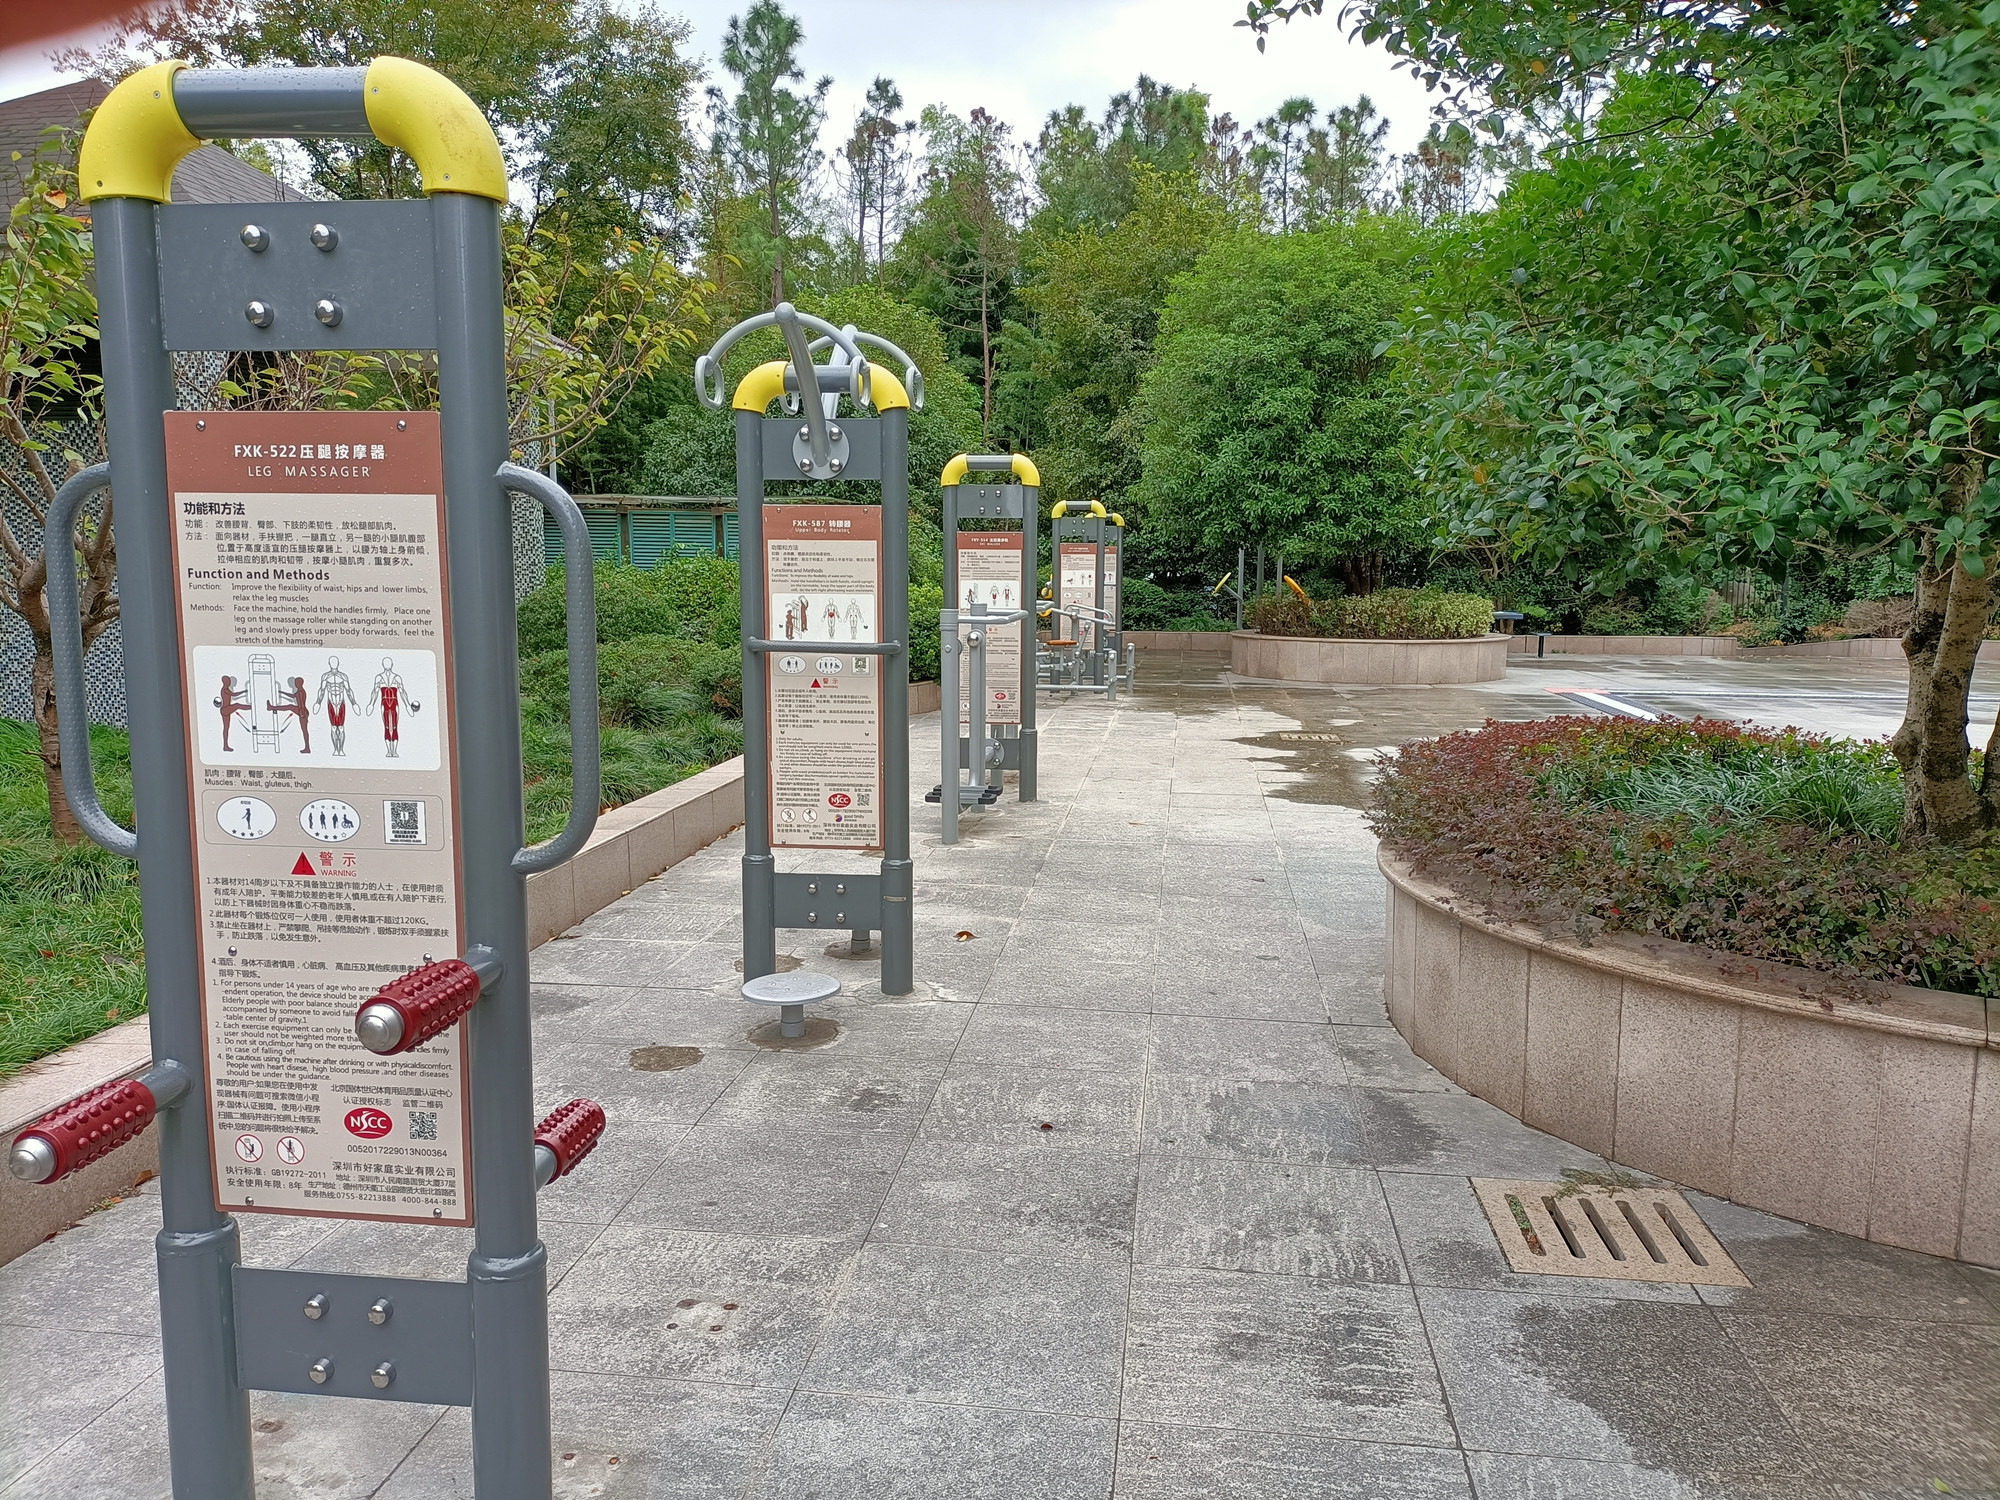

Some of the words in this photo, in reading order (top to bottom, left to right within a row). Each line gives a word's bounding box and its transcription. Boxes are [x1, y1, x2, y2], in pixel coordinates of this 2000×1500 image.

[233, 444, 385, 460] FXK-522压腿按摩器
[248, 465, 271, 476] LEG
[285, 465, 370, 477] MASSAGER
[183, 501, 245, 515] 功能和方法
[187, 567, 242, 579] Function
[245, 568, 269, 579] and
[272, 568, 329, 580] Methods
[231, 582, 262, 592] Improve
[278, 583, 312, 593] flexibility
[346, 584, 362, 594] hips
[232, 593, 250, 601] relax
[265, 594, 277, 603] leg
[279, 594, 309, 602] muscles
[333, 605, 363, 613] handles
[393, 606, 414, 614] Place
[233, 614, 245, 624] leg
[272, 617, 305, 625] massage
[327, 616, 348, 624] while
[349, 616, 388, 626] stangding
[401, 617, 432, 625] another
[234, 625, 246, 634] leg
[265, 626, 289, 635] slowly
[339, 627, 360, 637] body
[404, 628, 419, 636] feel
[421, 628, 434, 636] the
[234, 636, 260, 644] stretch
[261, 636, 270, 644] of
[271, 636, 284, 644] the
[240, 779, 262, 787] Waist,
[264, 780, 292, 789] gluteus,
[831, 795, 848, 804] NSCC
[319, 851, 356, 867] 警示
[320, 869, 356, 877] WARNING
[241, 1022, 269, 1030] exercise
[270, 1022, 309, 1033] equipment
[325, 1026, 341, 1034] only
[235, 1053, 261, 1061] cautious
[262, 1054, 281, 1064] using
[281, 1055, 292, 1063] the
[293, 1056, 321, 1064] machine
[338, 1058, 365, 1067] drinking
[226, 1060, 249, 1070] People
[266, 1062, 284, 1070] heart
[312, 1064, 327, 1074] high
[329, 1065, 349, 1073] blood
[351, 1066, 380, 1076] pressure
[398, 1068, 417, 1076] other
[419, 1070, 449, 1078] diseases
[226, 1068, 249, 1076] should
[342, 1096, 391, 1106] 认证授权标志
[402, 1099, 443, 1109] 监管二维码
[349, 1110, 387, 1132] NSCC
[347, 1144, 447, 1157] 0052017229013N00364
[271, 1168, 325, 1179] GB19272-2011
[331, 1160, 455, 1177] 深圳市好家庭实业有限公司
[401, 1195, 456, 1206] 4000-844-888
